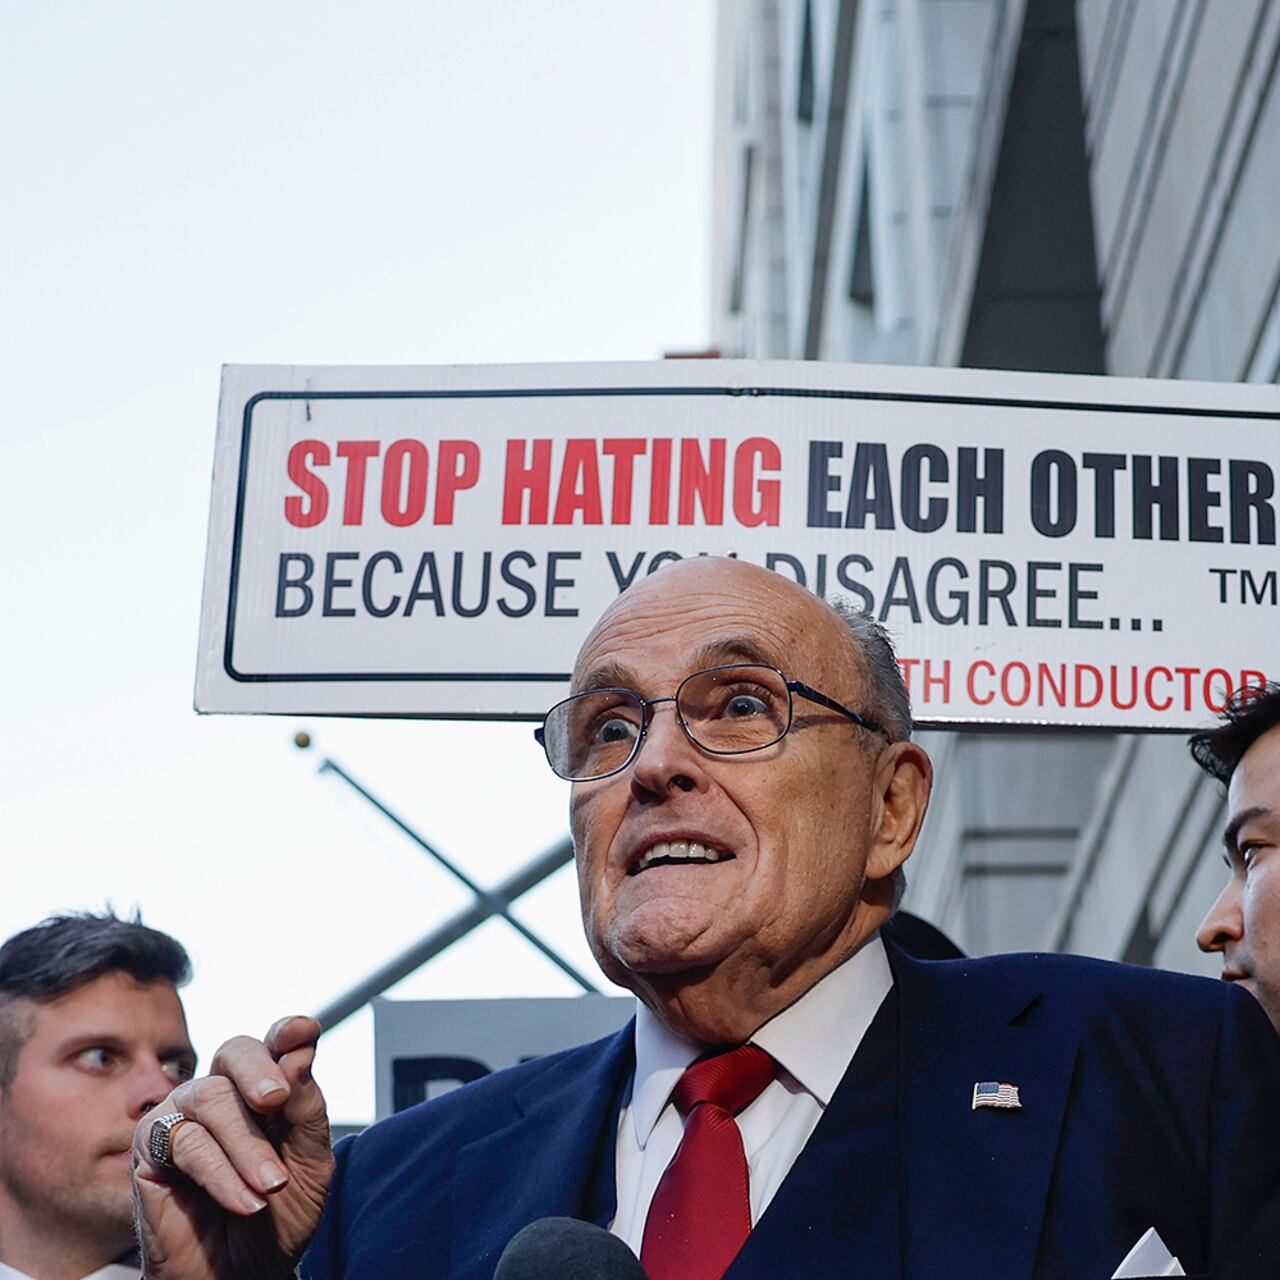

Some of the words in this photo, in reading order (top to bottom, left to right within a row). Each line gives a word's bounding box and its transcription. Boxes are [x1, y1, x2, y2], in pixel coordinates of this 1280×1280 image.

[284, 439, 481, 528] STOP
[501, 437, 782, 528] HATING
[806, 440, 1004, 534] EACH
[1029, 448, 1276, 545] OTHER
[275, 551, 582, 619] BECAUSE
[1209, 567, 1278, 606] TM
